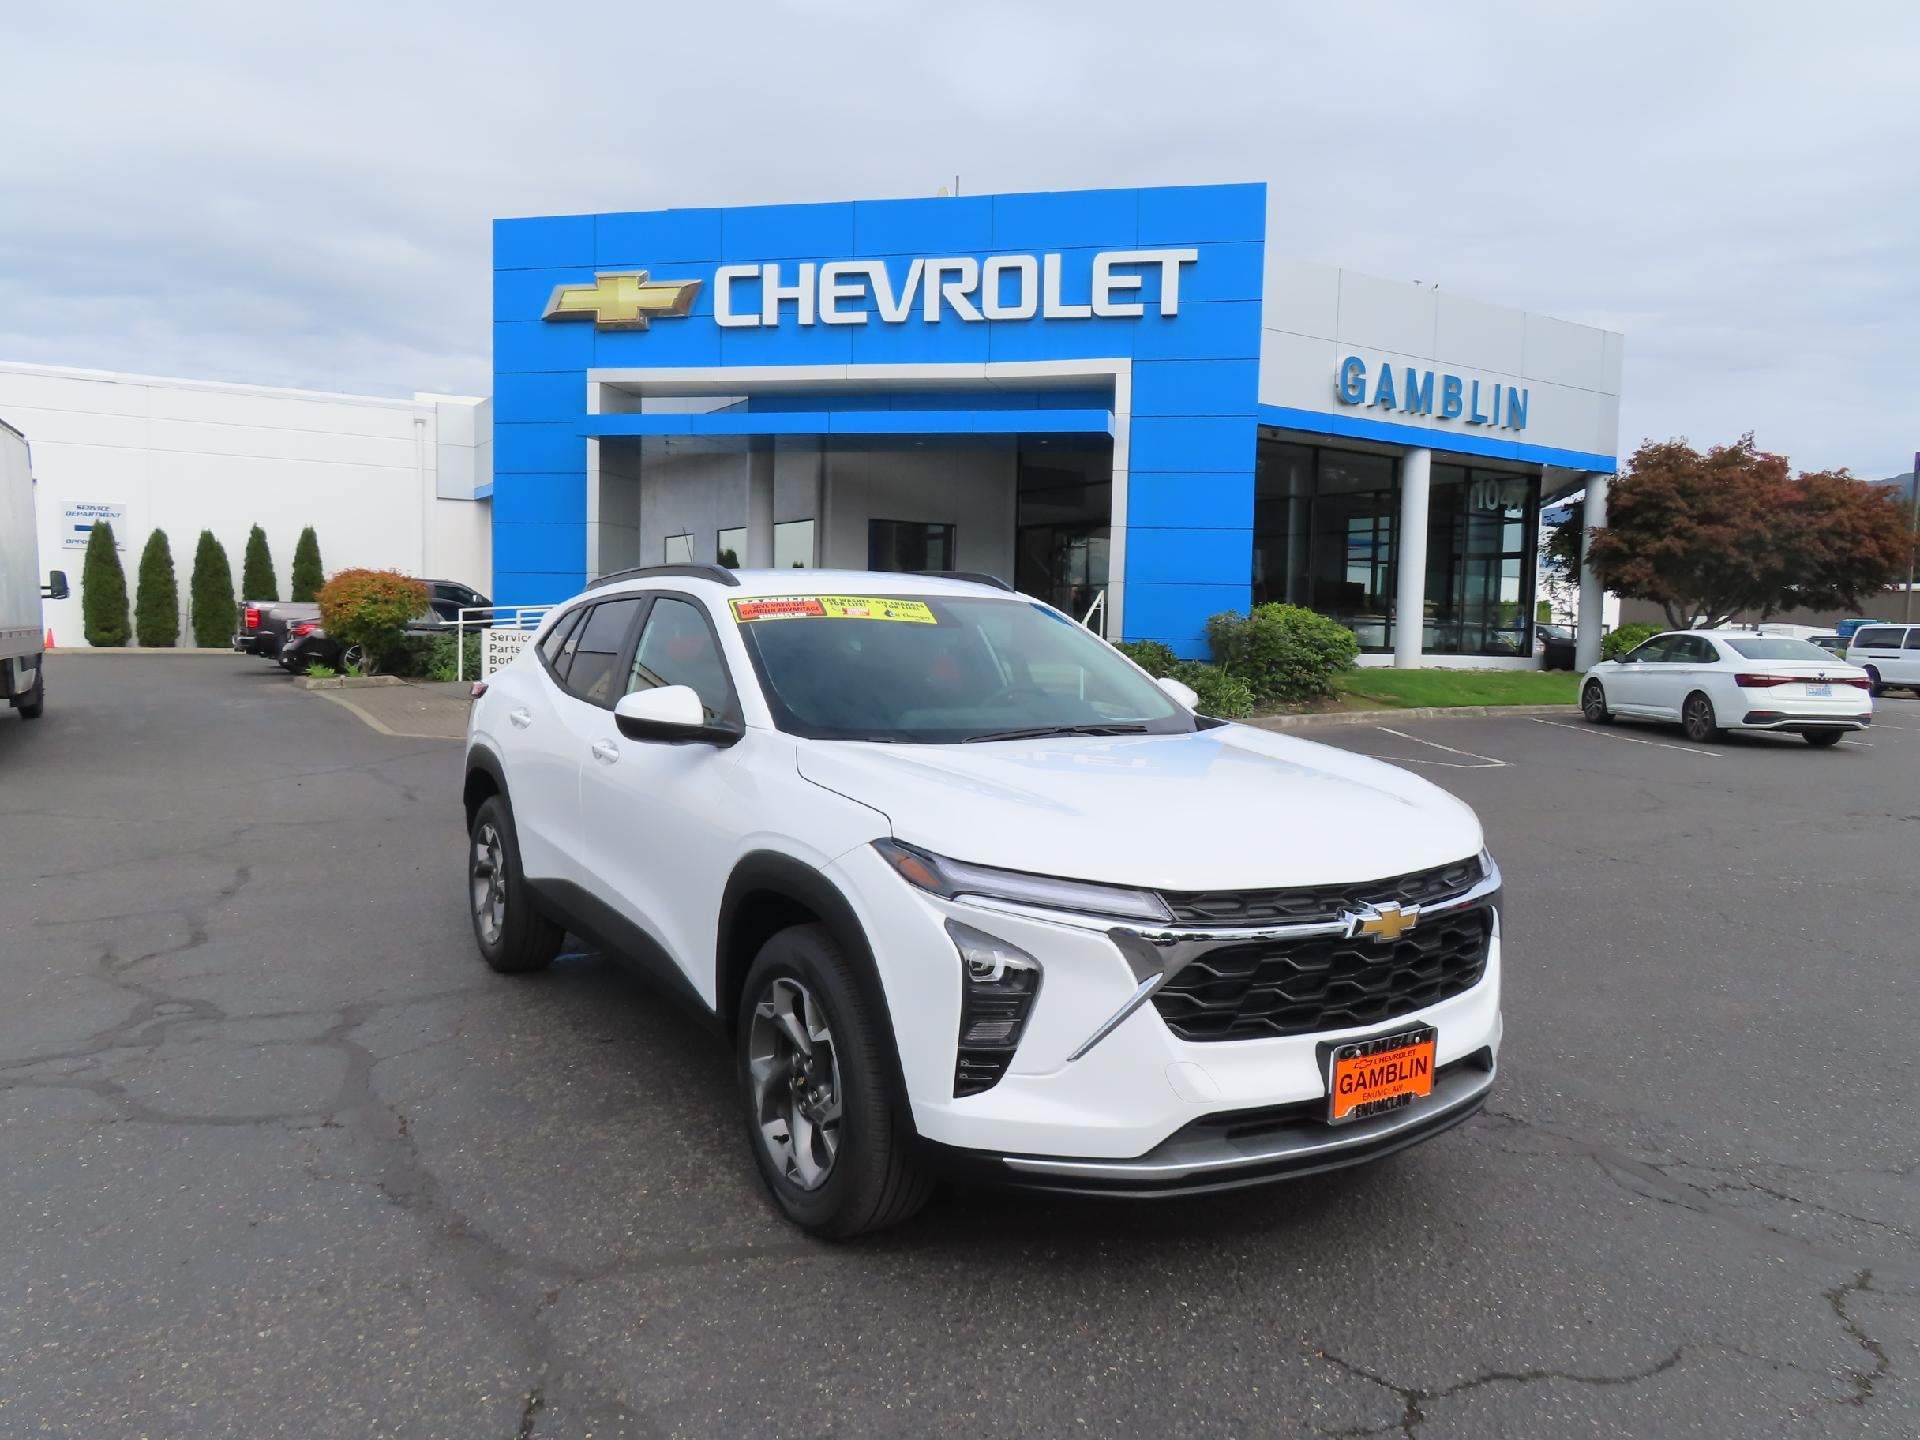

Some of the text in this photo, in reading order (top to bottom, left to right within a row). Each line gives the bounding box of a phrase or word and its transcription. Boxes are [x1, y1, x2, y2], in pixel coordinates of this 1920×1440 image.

[713, 248, 1198, 327] CHEVROLET
[1336, 355, 1529, 431] GAMBLIN
[76, 504, 111, 512] SERVICE
[489, 643, 520, 654] Parts
[489, 655, 513, 665] Bod
[1373, 1048, 1416, 1065] CHEVROLET
[1339, 1055, 1428, 1094] GAMBLIN
[1355, 1092, 1413, 1118] ENUMCLAW
